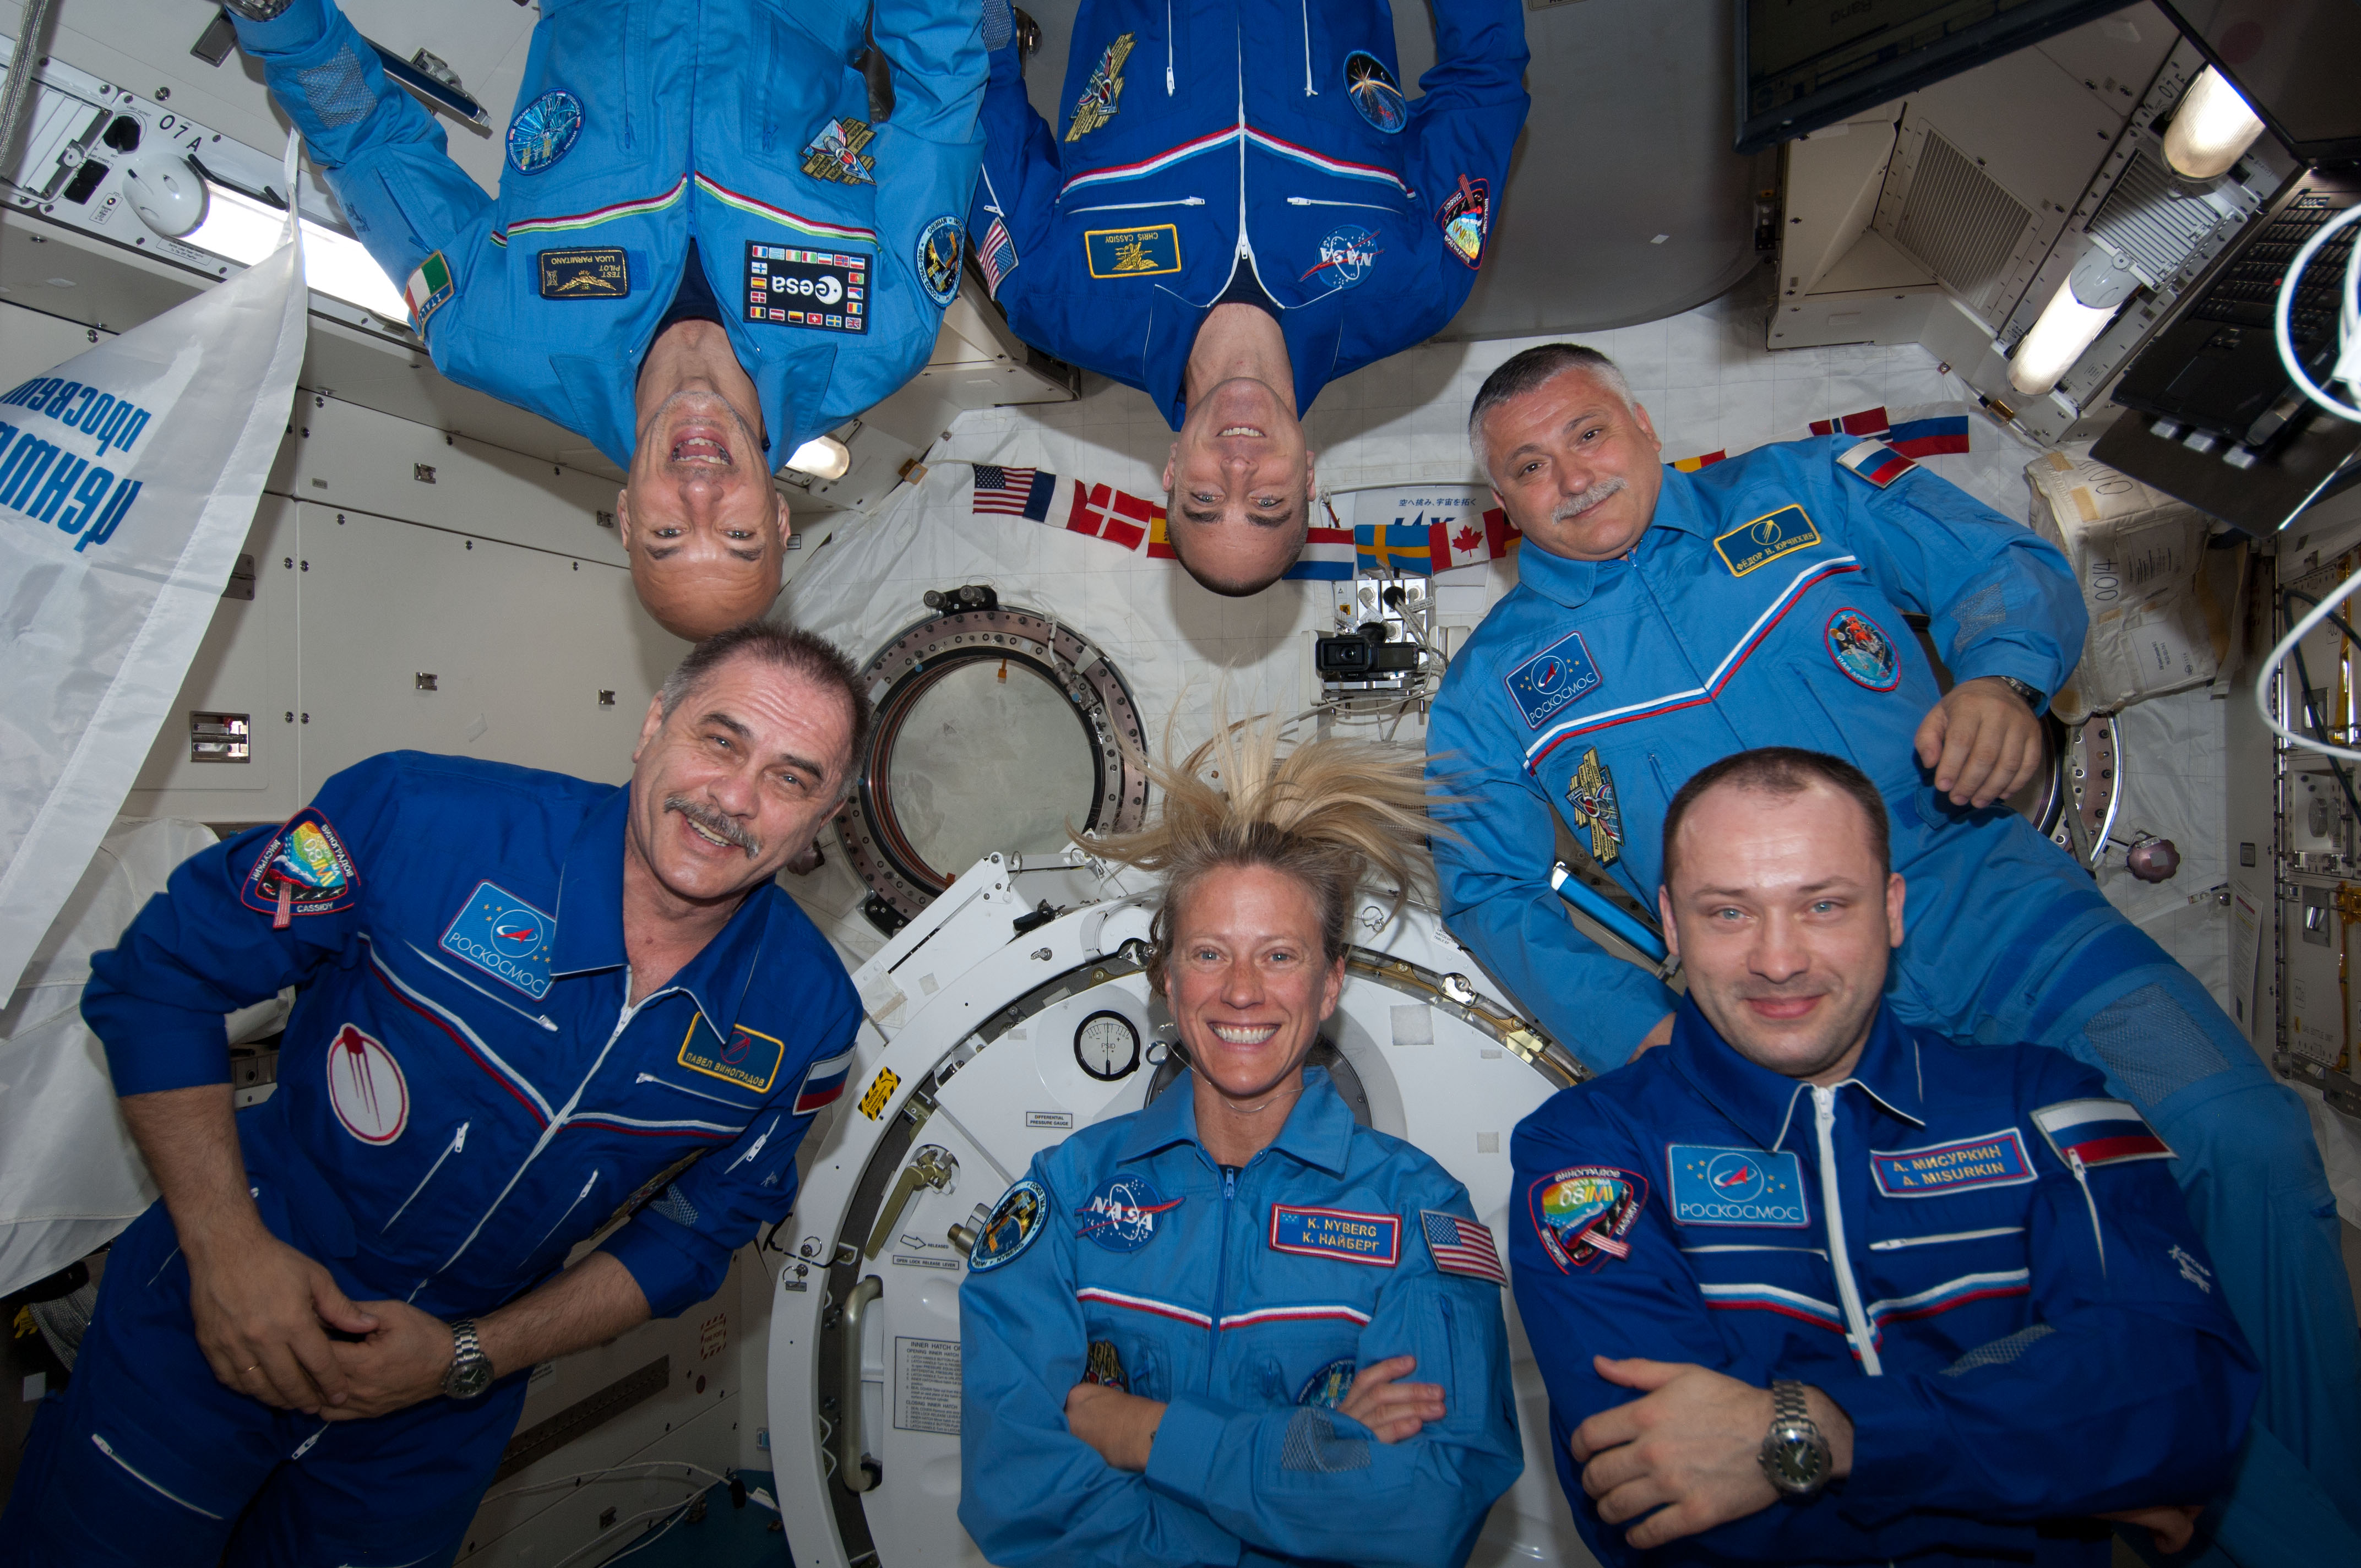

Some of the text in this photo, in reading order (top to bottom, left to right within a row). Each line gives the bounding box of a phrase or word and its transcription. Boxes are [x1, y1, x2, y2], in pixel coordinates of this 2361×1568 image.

[927, 217, 946, 233] NYBERG
[1105, 232, 1158, 243] CHRIS CASSIDY
[551, 256, 592, 265] PARMITANO
[1319, 247, 1373, 266] NASA
[770, 271, 843, 305] esa
[1399, 498, 1476, 507] 空へ挑み、宇宙を拓く
[1734, 530, 1814, 571] ФЁДОР Н. ЮРЧИХИН
[2092, 558, 2119, 601] 0014
[1528, 672, 1596, 722] РОСКОСМОС
[250, 839, 281, 881] МИСУРКИН
[320, 824, 354, 878] ВИНОГРАДОВ
[296, 902, 333, 912] CASSIDY
[449, 931, 545, 994] РОСКОСМОС
[684, 1052, 764, 1086] ПАВЕЛ ВИНОГРАДОВ
[864, 1088, 879, 1108] CAUTION
[1892, 1145, 2001, 1173] А. МИСУРКИН
[1554, 1168, 1620, 1182] ВИНОГРАДОВ
[1902, 1161, 2005, 1187] A. MISURKIN
[1089, 1196, 1152, 1231] NASA
[1679, 1201, 1800, 1222] РОСКОСМОС
[1307, 1217, 1377, 1237] K. NYBERG
[996, 1243, 1024, 1262] NYBERG
[1302, 1231, 1380, 1253] К. НАЙБЕРГ
